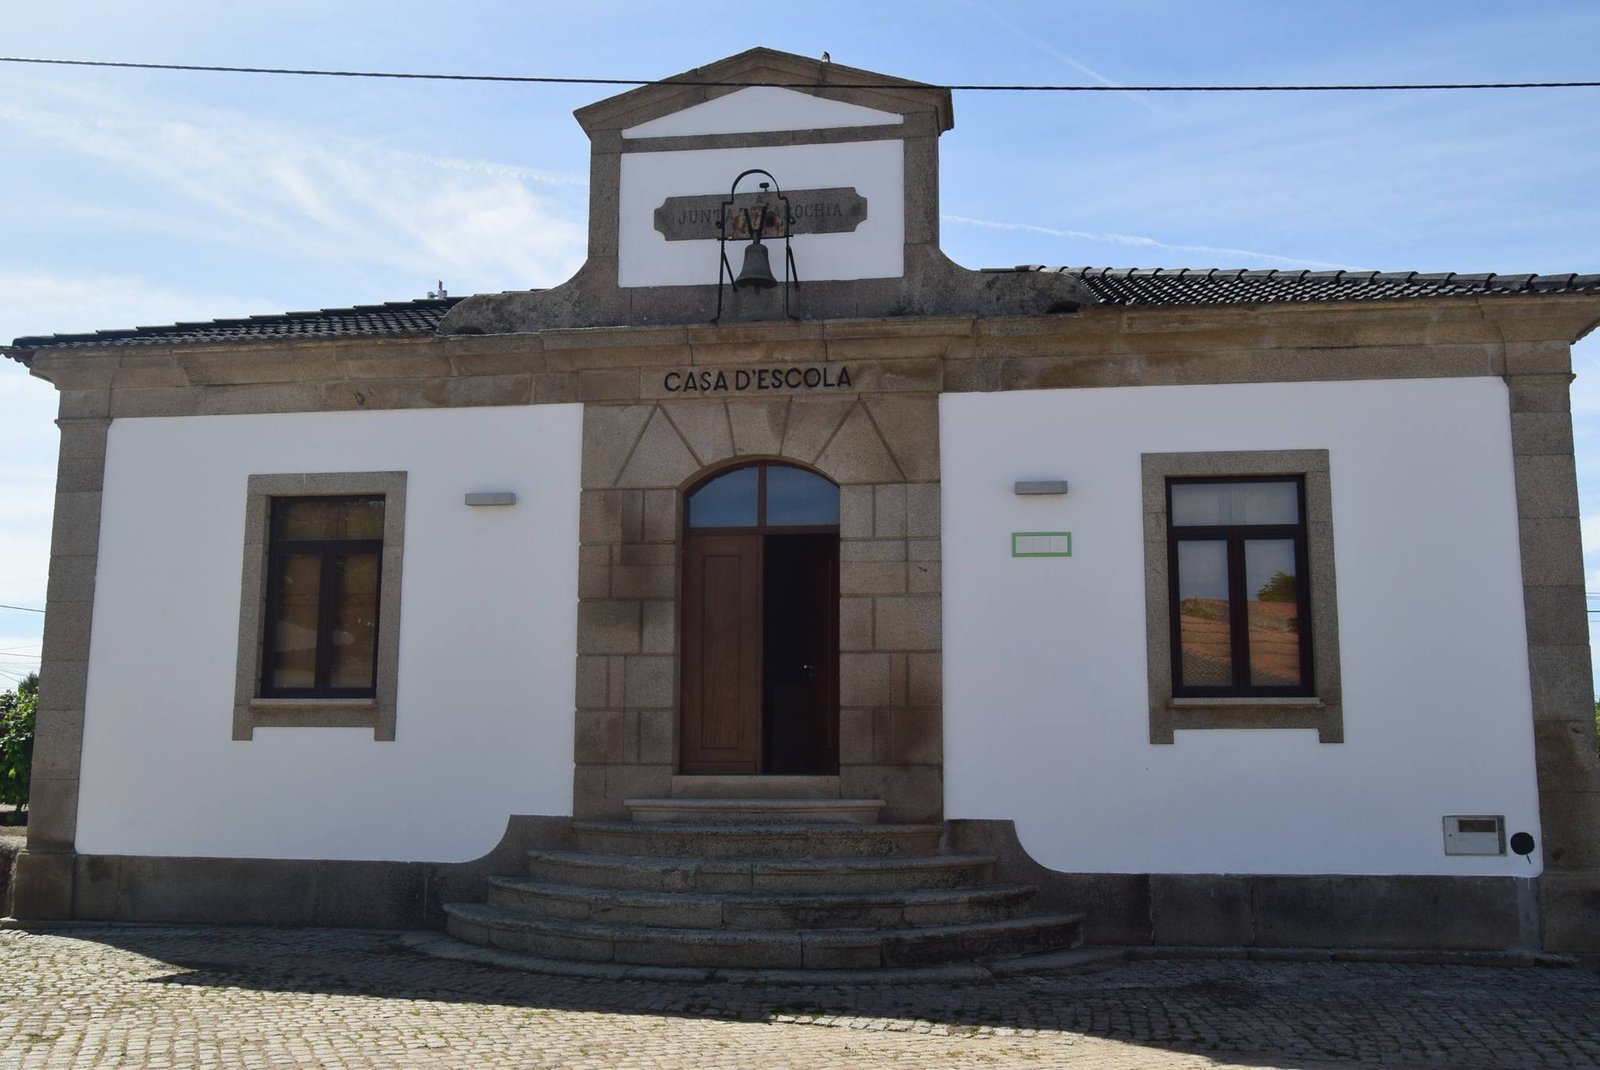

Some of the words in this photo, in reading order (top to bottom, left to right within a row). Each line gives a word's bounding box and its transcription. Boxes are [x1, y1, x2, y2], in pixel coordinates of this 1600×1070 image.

[679, 207, 734, 225] JUNTA
[664, 370, 728, 392] CASA
[735, 366, 852, 391] D'ESCOLA
